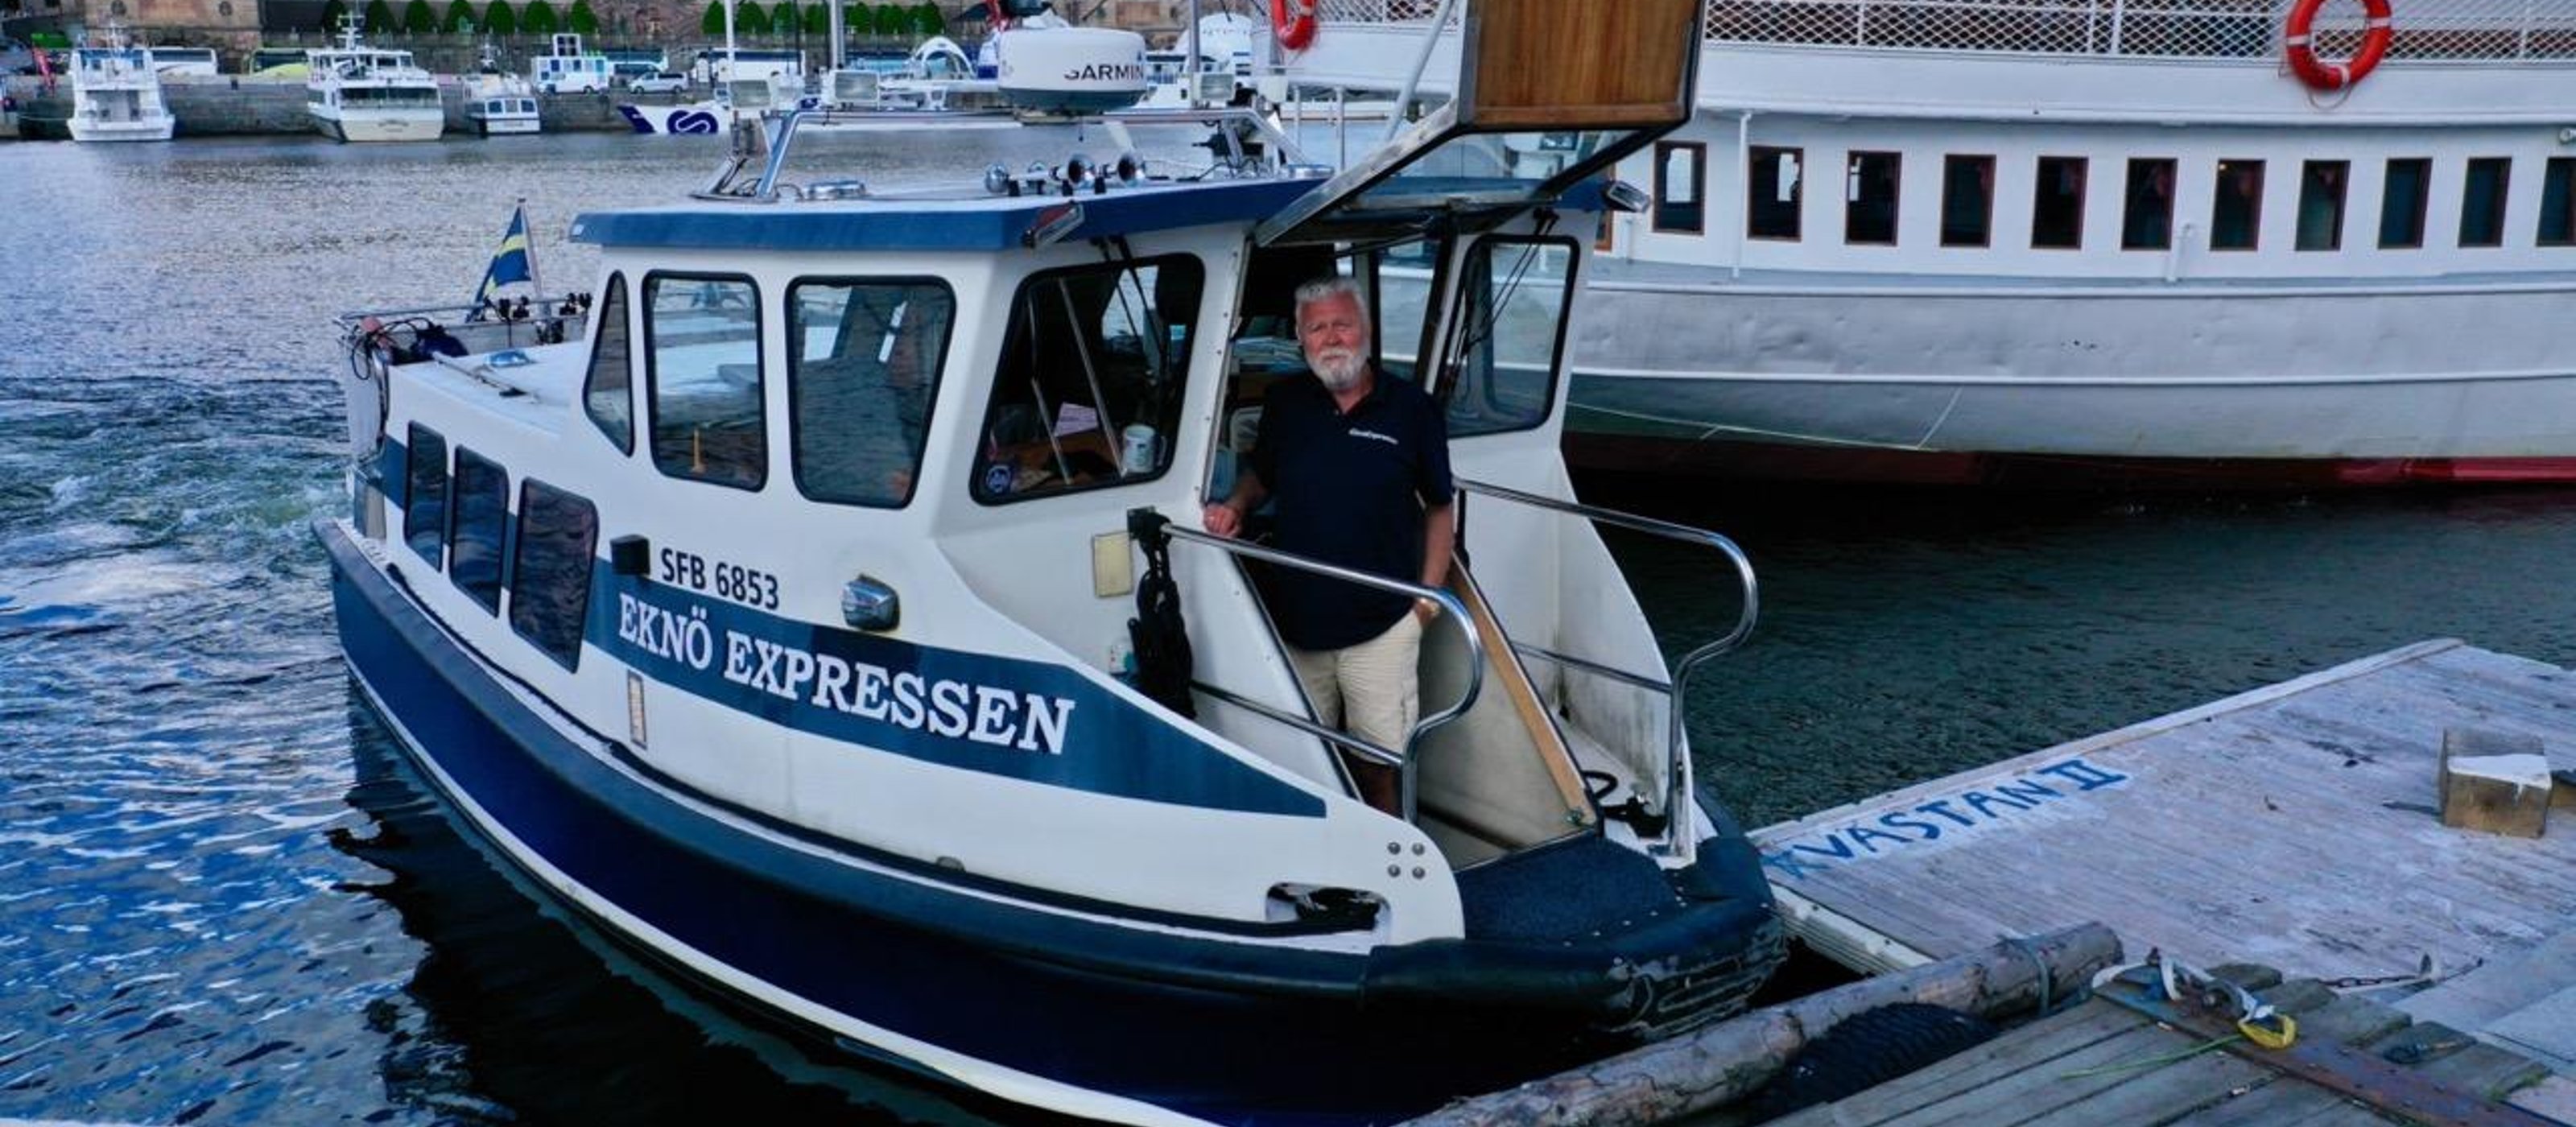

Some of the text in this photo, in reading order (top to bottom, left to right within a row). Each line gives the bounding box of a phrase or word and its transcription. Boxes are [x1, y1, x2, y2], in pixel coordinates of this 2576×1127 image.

[660, 547, 779, 610] SFB 6853
[618, 592, 1076, 755] EKNÖ EXPRESSEN
[1761, 759, 2127, 880] KVASTAN II
